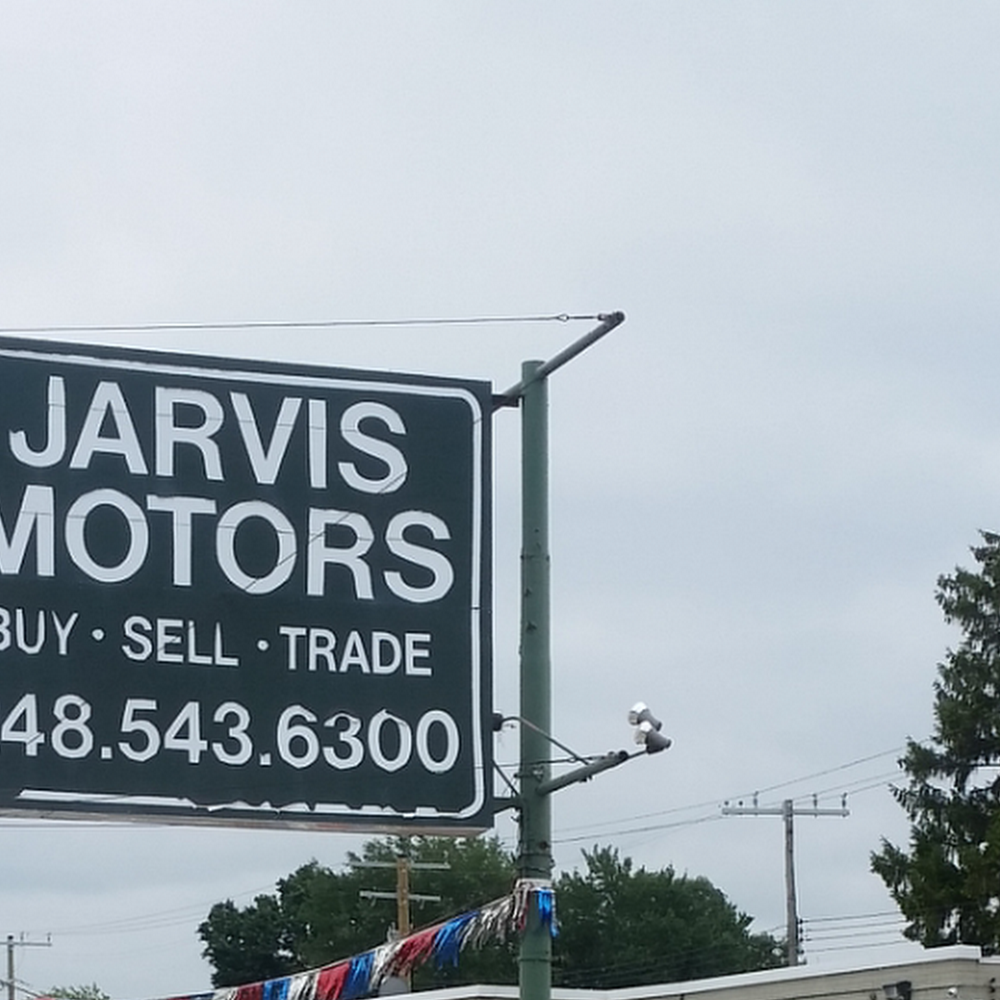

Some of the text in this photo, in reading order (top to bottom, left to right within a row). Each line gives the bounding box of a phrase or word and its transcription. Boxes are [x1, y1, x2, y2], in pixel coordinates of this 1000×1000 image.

[8, 375, 408, 495] JARVIS
[0, 484, 455, 604] MOTORS
[121, 615, 240, 667] SELL
[279, 625, 433, 677] TRADE
[0, 693, 461, 774] 48.543.6300
